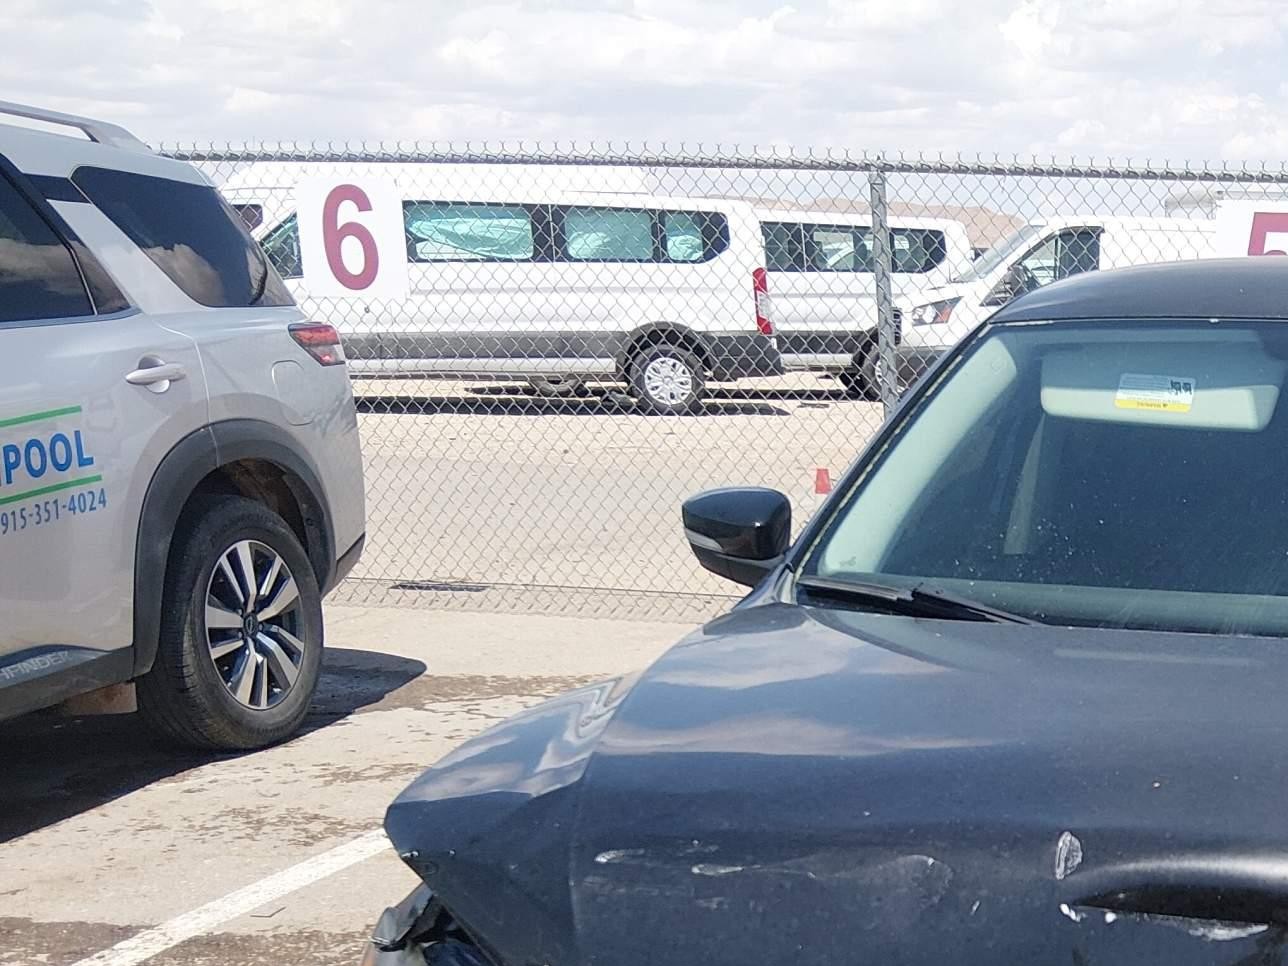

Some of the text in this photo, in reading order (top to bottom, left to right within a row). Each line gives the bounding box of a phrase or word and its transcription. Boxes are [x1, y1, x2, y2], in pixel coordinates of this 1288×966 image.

[322, 184, 379, 290] 6
[0, 430, 94, 487] POOL
[0, 488, 107, 535] 915-351-4024
